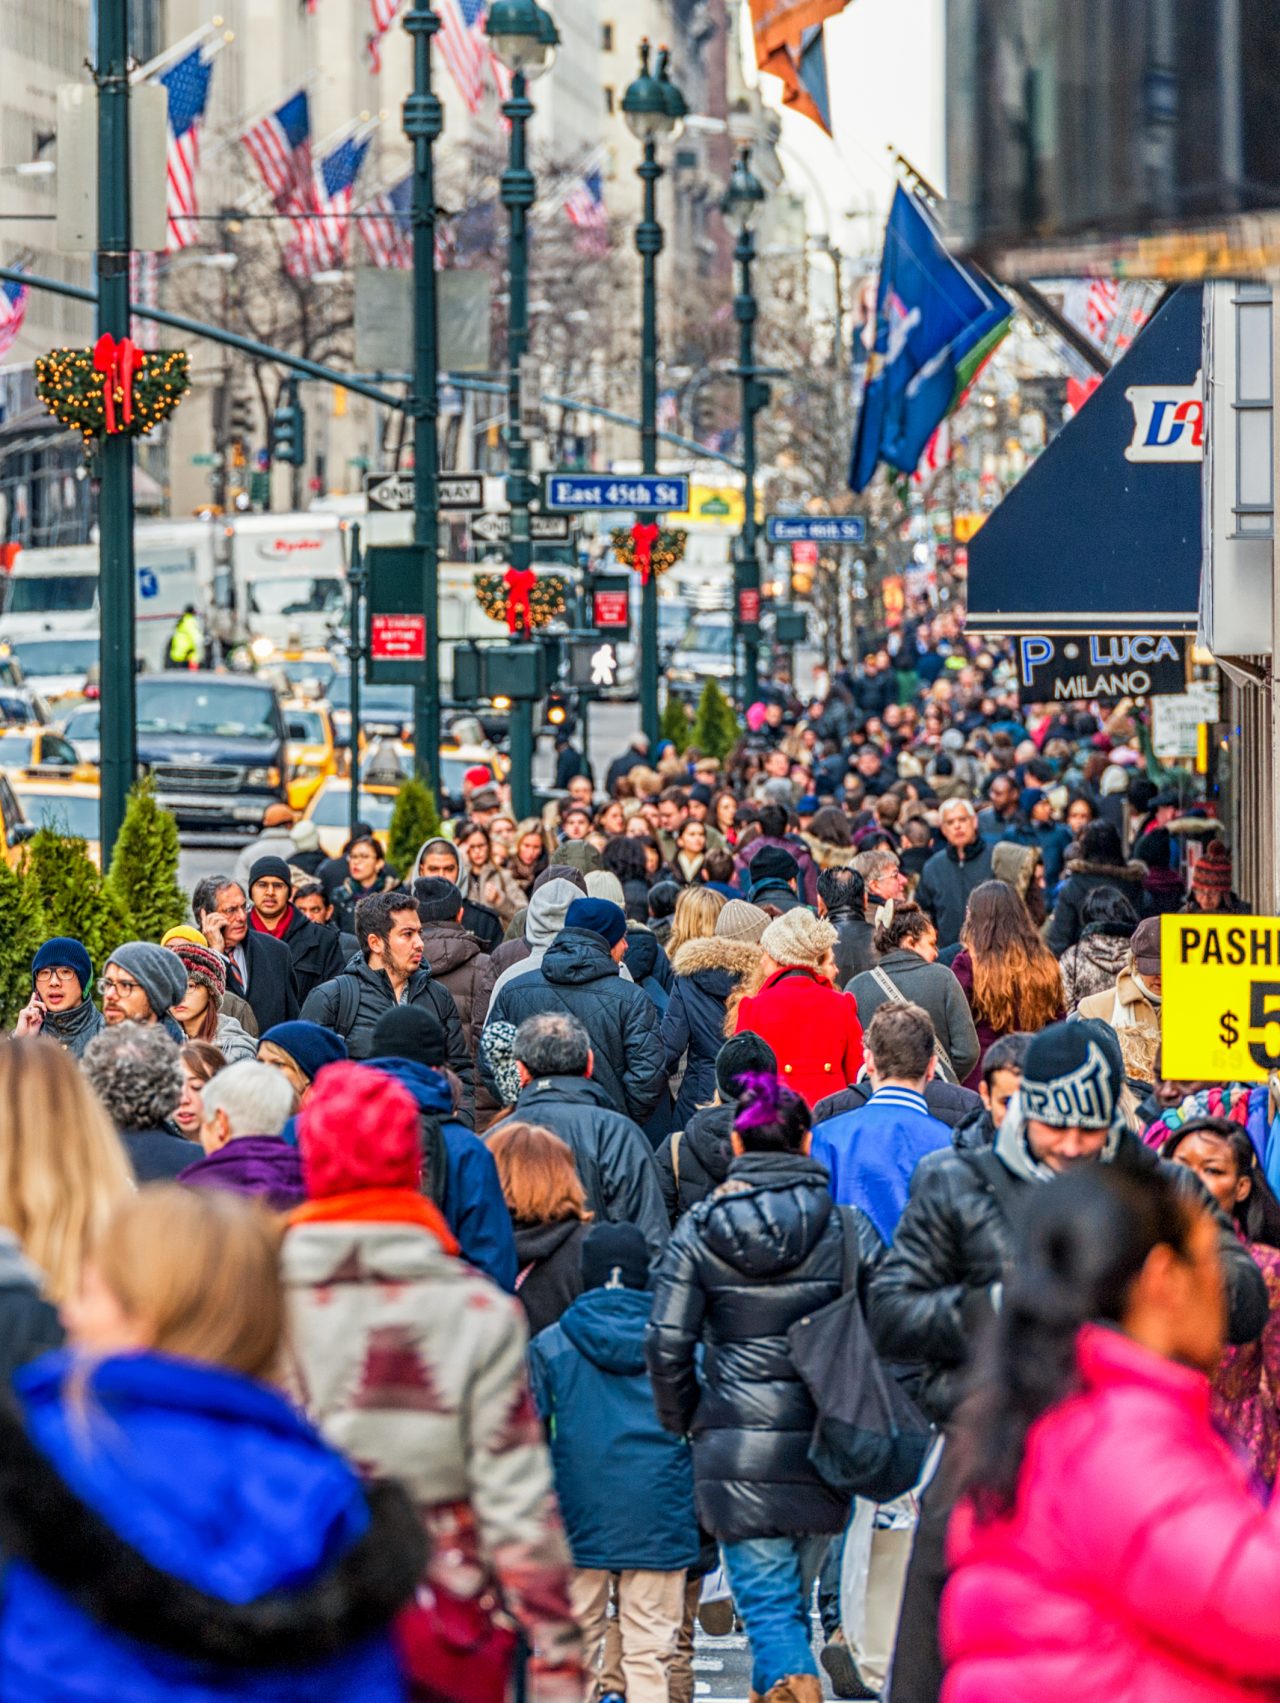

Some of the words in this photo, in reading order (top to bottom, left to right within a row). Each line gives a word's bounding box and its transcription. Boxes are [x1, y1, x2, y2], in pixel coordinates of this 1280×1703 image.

[378, 485, 415, 500] ONE
[556, 483, 601, 504] East
[605, 482, 651, 504] 45th
[655, 483, 678, 504] St
[274, 538, 323, 551] Ryder
[1089, 635, 1180, 667] LUCA
[1054, 670, 1151, 700] MILANO
[1180, 927, 1280, 966] PASH
